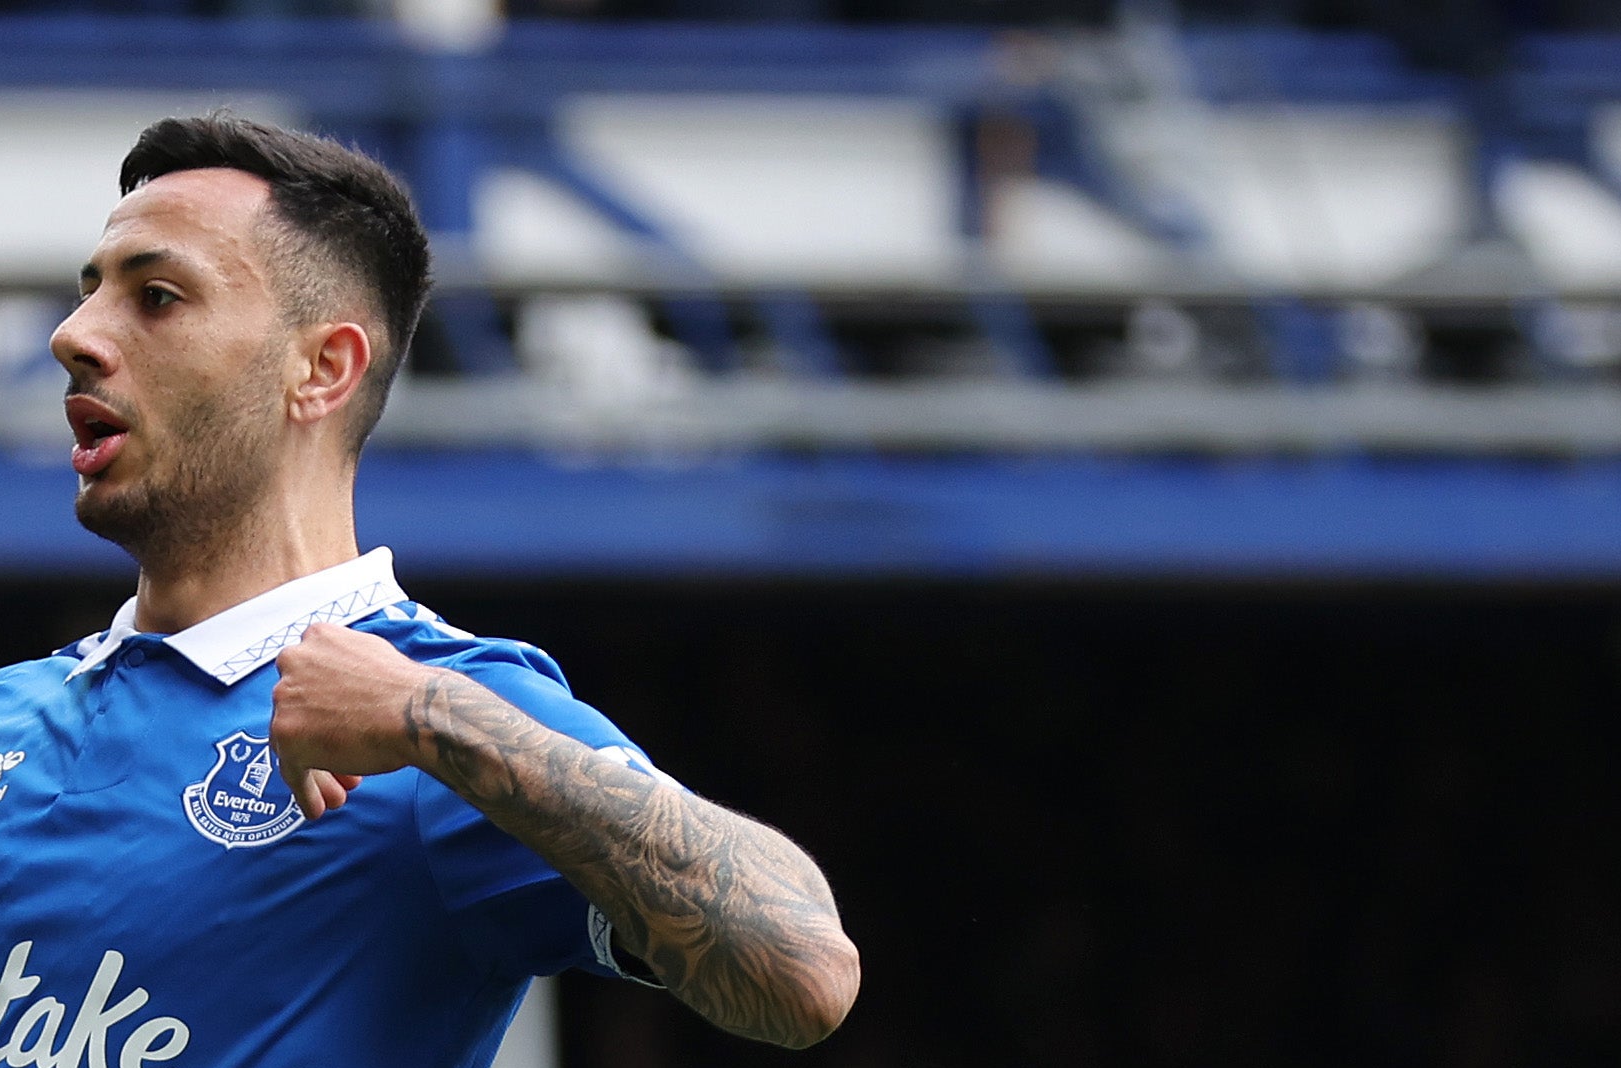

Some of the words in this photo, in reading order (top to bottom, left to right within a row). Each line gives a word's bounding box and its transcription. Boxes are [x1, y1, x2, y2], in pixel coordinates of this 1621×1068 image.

[213, 791, 276, 815] Everton
[198, 815, 222, 836] SATIS
[223, 833, 246, 841] NISI
[247, 817, 294, 841] OPTIMUM
